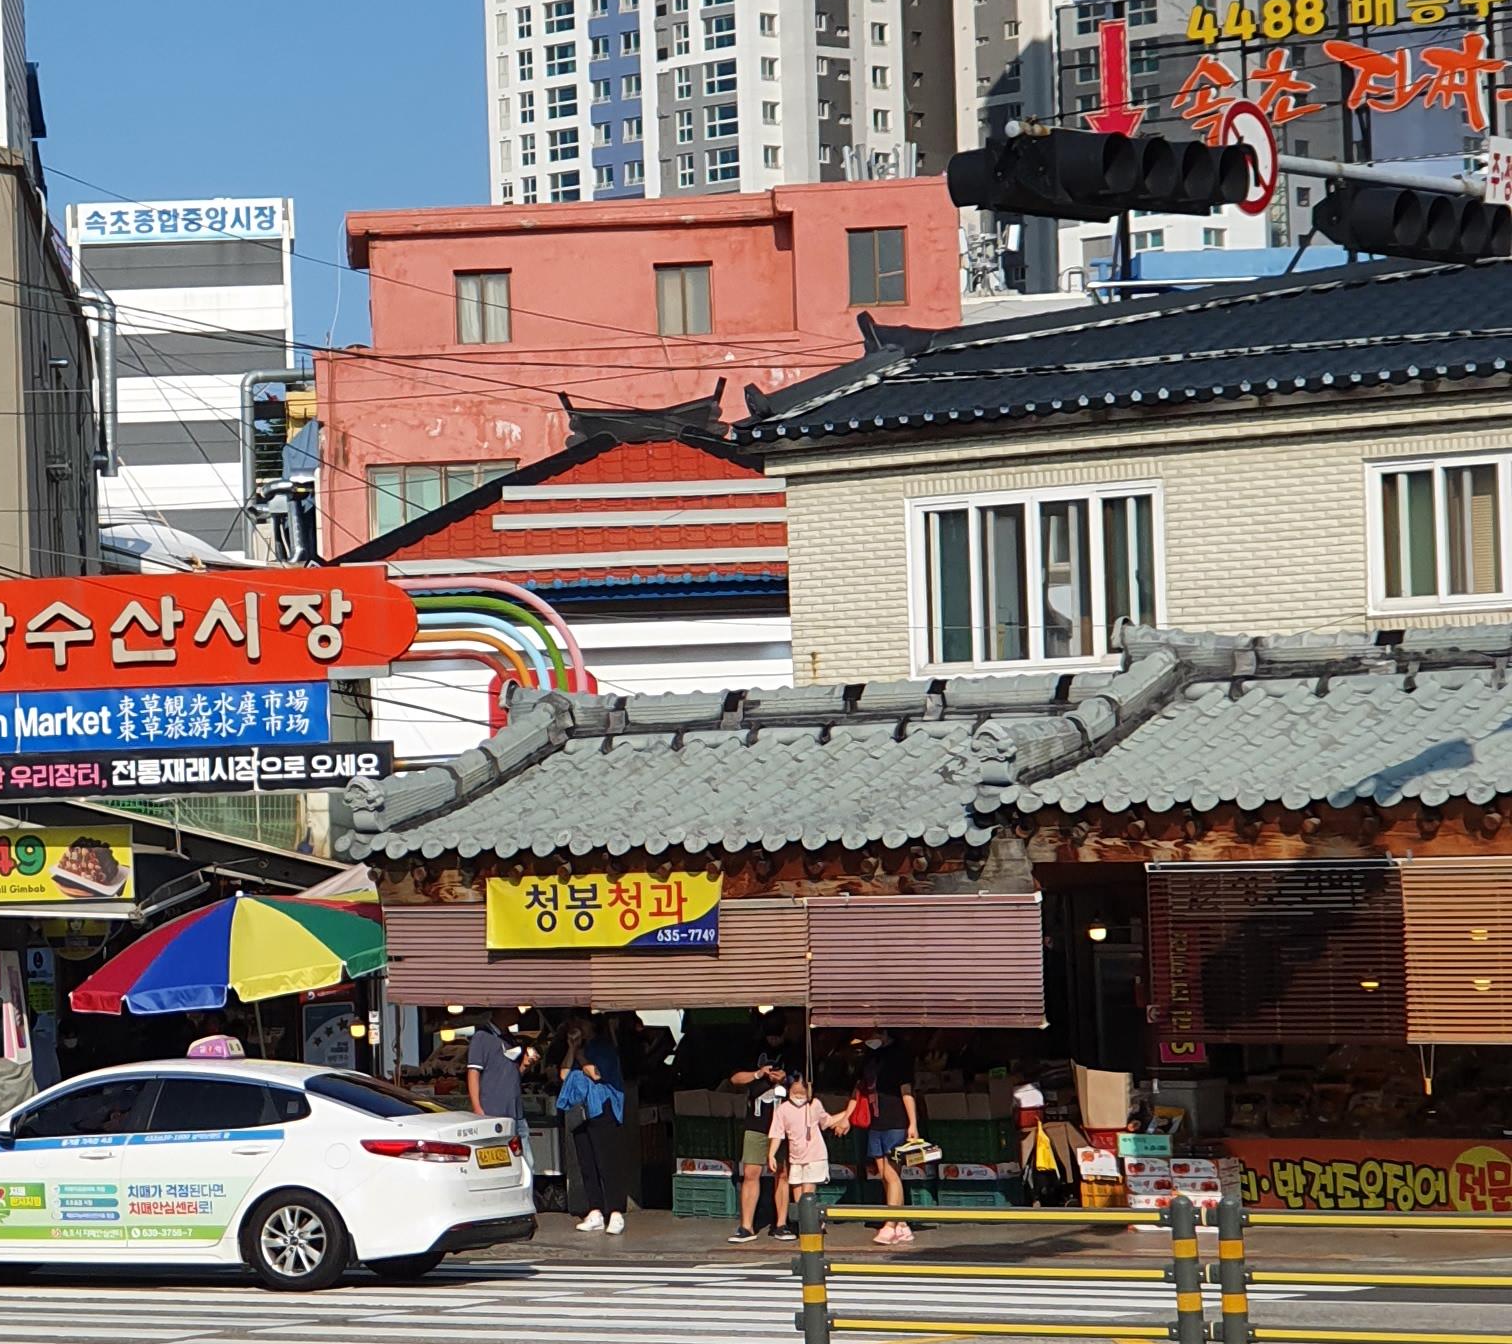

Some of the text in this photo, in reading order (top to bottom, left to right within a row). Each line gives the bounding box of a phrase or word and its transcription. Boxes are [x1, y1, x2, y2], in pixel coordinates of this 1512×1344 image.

[84, 206, 277, 236] 속초종합중앙시장
[14, 705, 112, 737] Market
[9, 761, 108, 789] 우리장터,
[111, 755, 306, 786] 전통재래시장으로
[310, 752, 380, 778] 오세요
[9, 884, 46, 894] Gimbab
[524, 880, 690, 933] 청봉청과
[656, 928, 716, 943] 635-7749
[128, 1184, 163, 1199] 치매가
